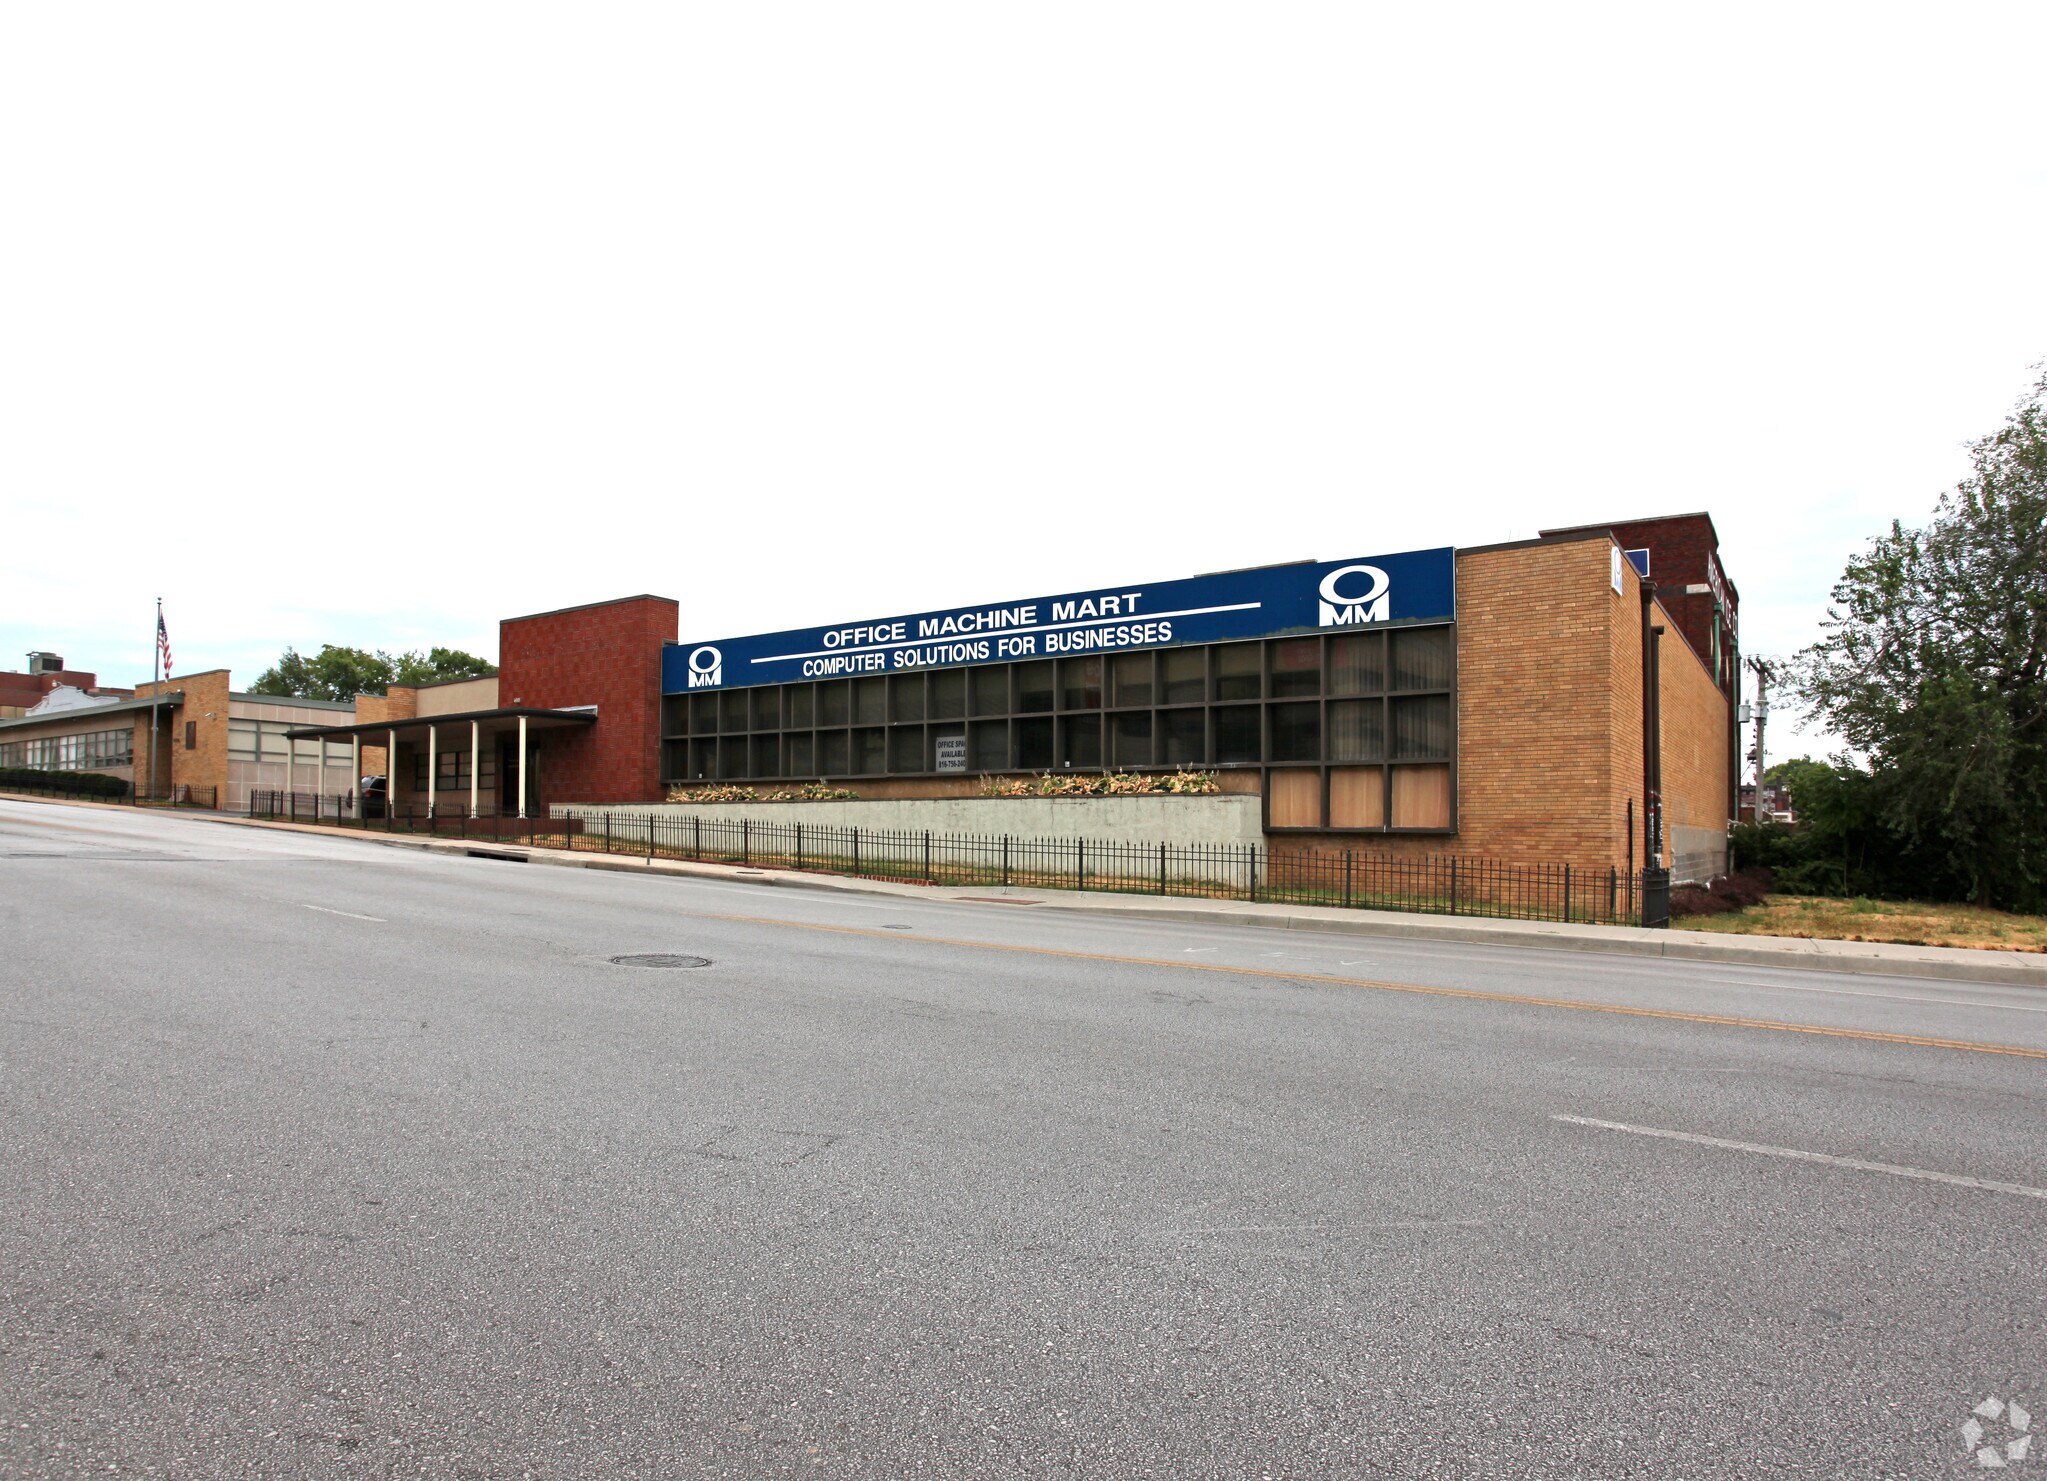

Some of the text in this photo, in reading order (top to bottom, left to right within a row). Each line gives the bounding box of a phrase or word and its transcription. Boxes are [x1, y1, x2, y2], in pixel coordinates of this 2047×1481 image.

[823, 592, 1142, 648] OFFICE MACHINE MART
[803, 621, 1173, 677] COMPUTER SOLUTIONS FOR BUSINESSES
